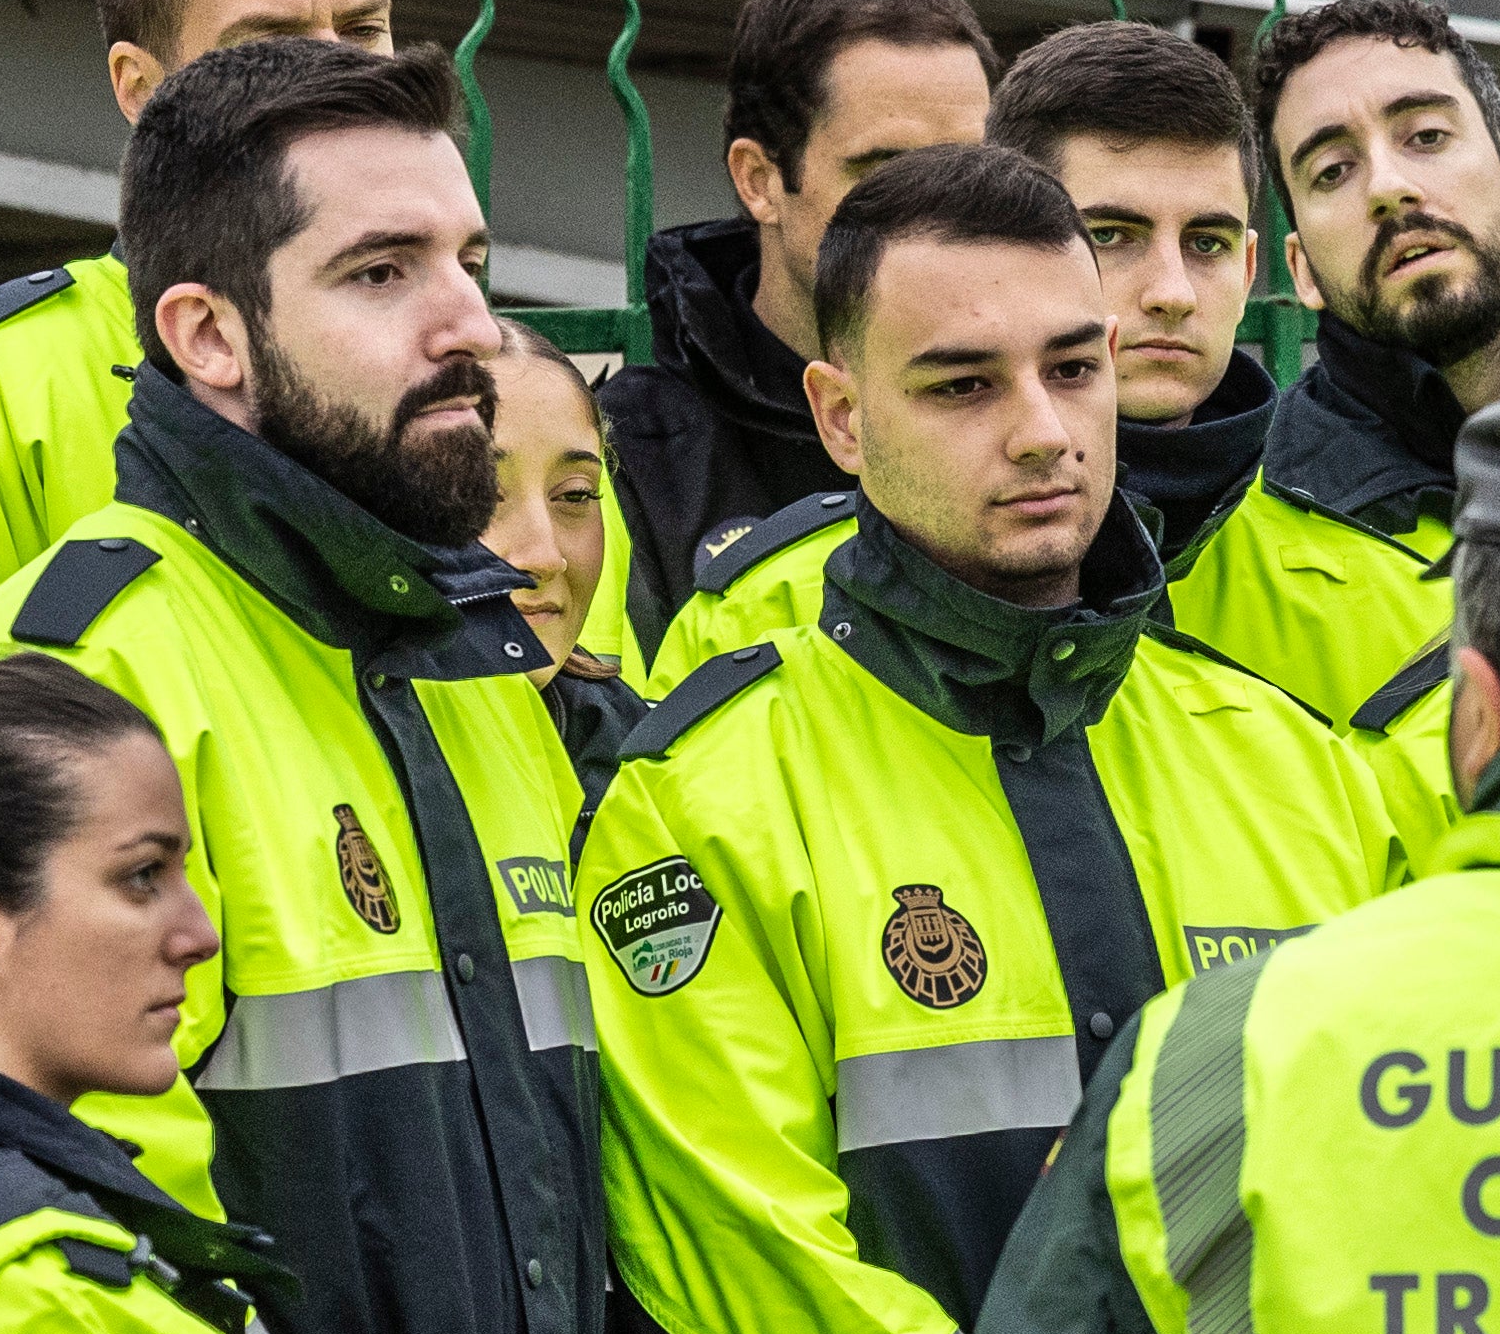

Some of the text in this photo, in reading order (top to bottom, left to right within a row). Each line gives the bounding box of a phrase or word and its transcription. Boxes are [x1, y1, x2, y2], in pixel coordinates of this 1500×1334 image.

[601, 873, 703, 924] Policía Loc
[625, 901, 690, 933] Logroño
[654, 946, 693, 964] La Rioja
